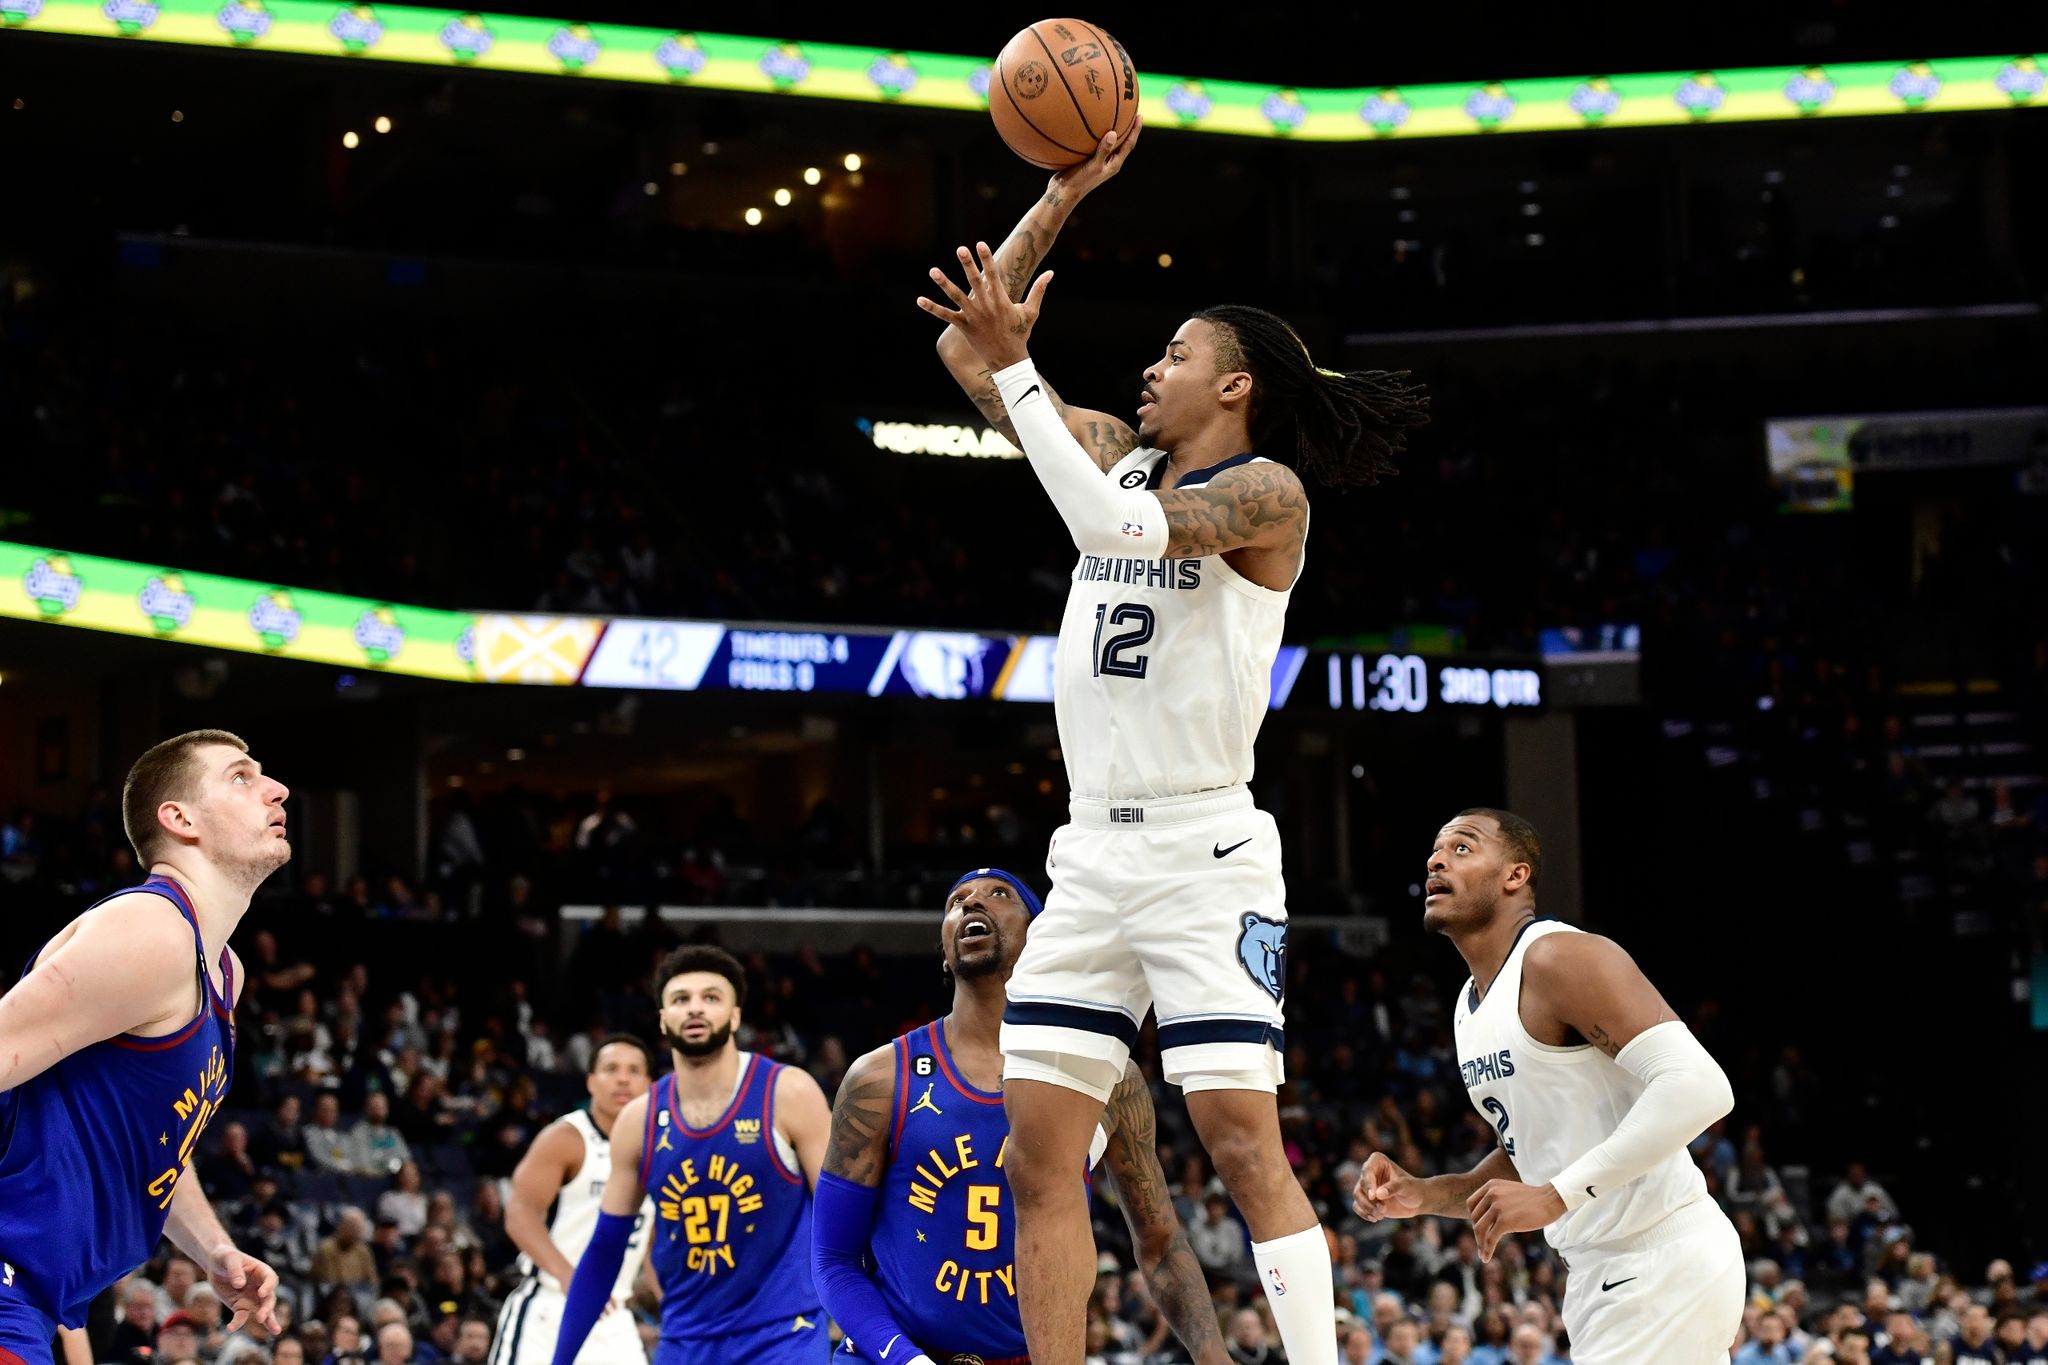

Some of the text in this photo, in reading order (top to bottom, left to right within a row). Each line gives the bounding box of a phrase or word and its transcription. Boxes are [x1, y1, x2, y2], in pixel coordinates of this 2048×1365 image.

[1122, 471, 1143, 488] 6
[1078, 556, 1202, 590] MEMPHIS
[629, 626, 680, 685] 42
[1092, 602, 1156, 680] 12
[1328, 653, 1540, 713] 11:30 3RD QTR
[915, 1057, 932, 1076] 6
[1459, 1050, 1515, 1089] EMPHIS
[734, 1118, 760, 1133] WU
[1482, 1096, 1516, 1157] 2
[658, 1154, 763, 1221] MILE HIGH
[908, 1133, 978, 1214] MILE
[681, 1194, 730, 1245] 27
[965, 1184, 1000, 1251] 5
[686, 1244, 736, 1276] CITY
[934, 1259, 1016, 1305] CITY
